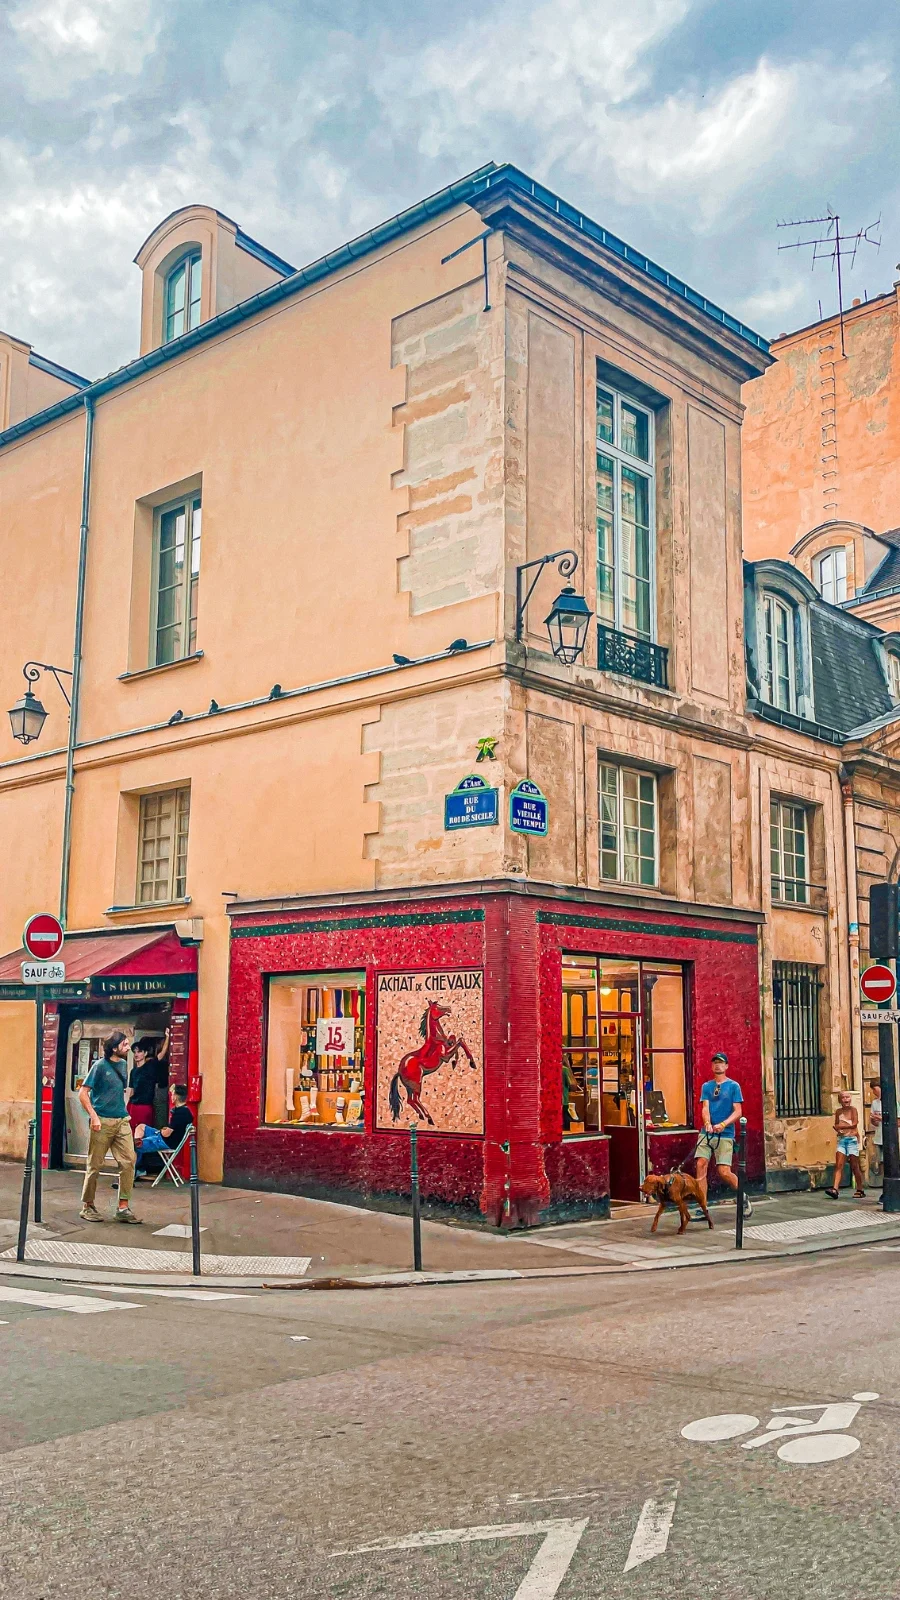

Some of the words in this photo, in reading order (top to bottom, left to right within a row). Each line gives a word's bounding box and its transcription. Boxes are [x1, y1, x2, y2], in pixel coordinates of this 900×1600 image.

[464, 796, 478, 805] RUE
[466, 805, 476, 814] DU
[523, 802, 536, 811] RUE
[449, 816, 461, 824] ROI
[461, 815, 470, 823] DE
[471, 812, 494, 822] SICILE
[517, 809, 541, 820] VIEILLE
[513, 818, 521, 826] DU
[522, 818, 546, 829] TEMPLE
[24, 968, 47, 978] SAUF
[119, 981, 141, 991] HOT
[145, 980, 166, 990] DOG
[379, 976, 415, 991] ACHAT
[425, 972, 482, 990] CHEVAUX
[327, 1026, 342, 1043] 15
